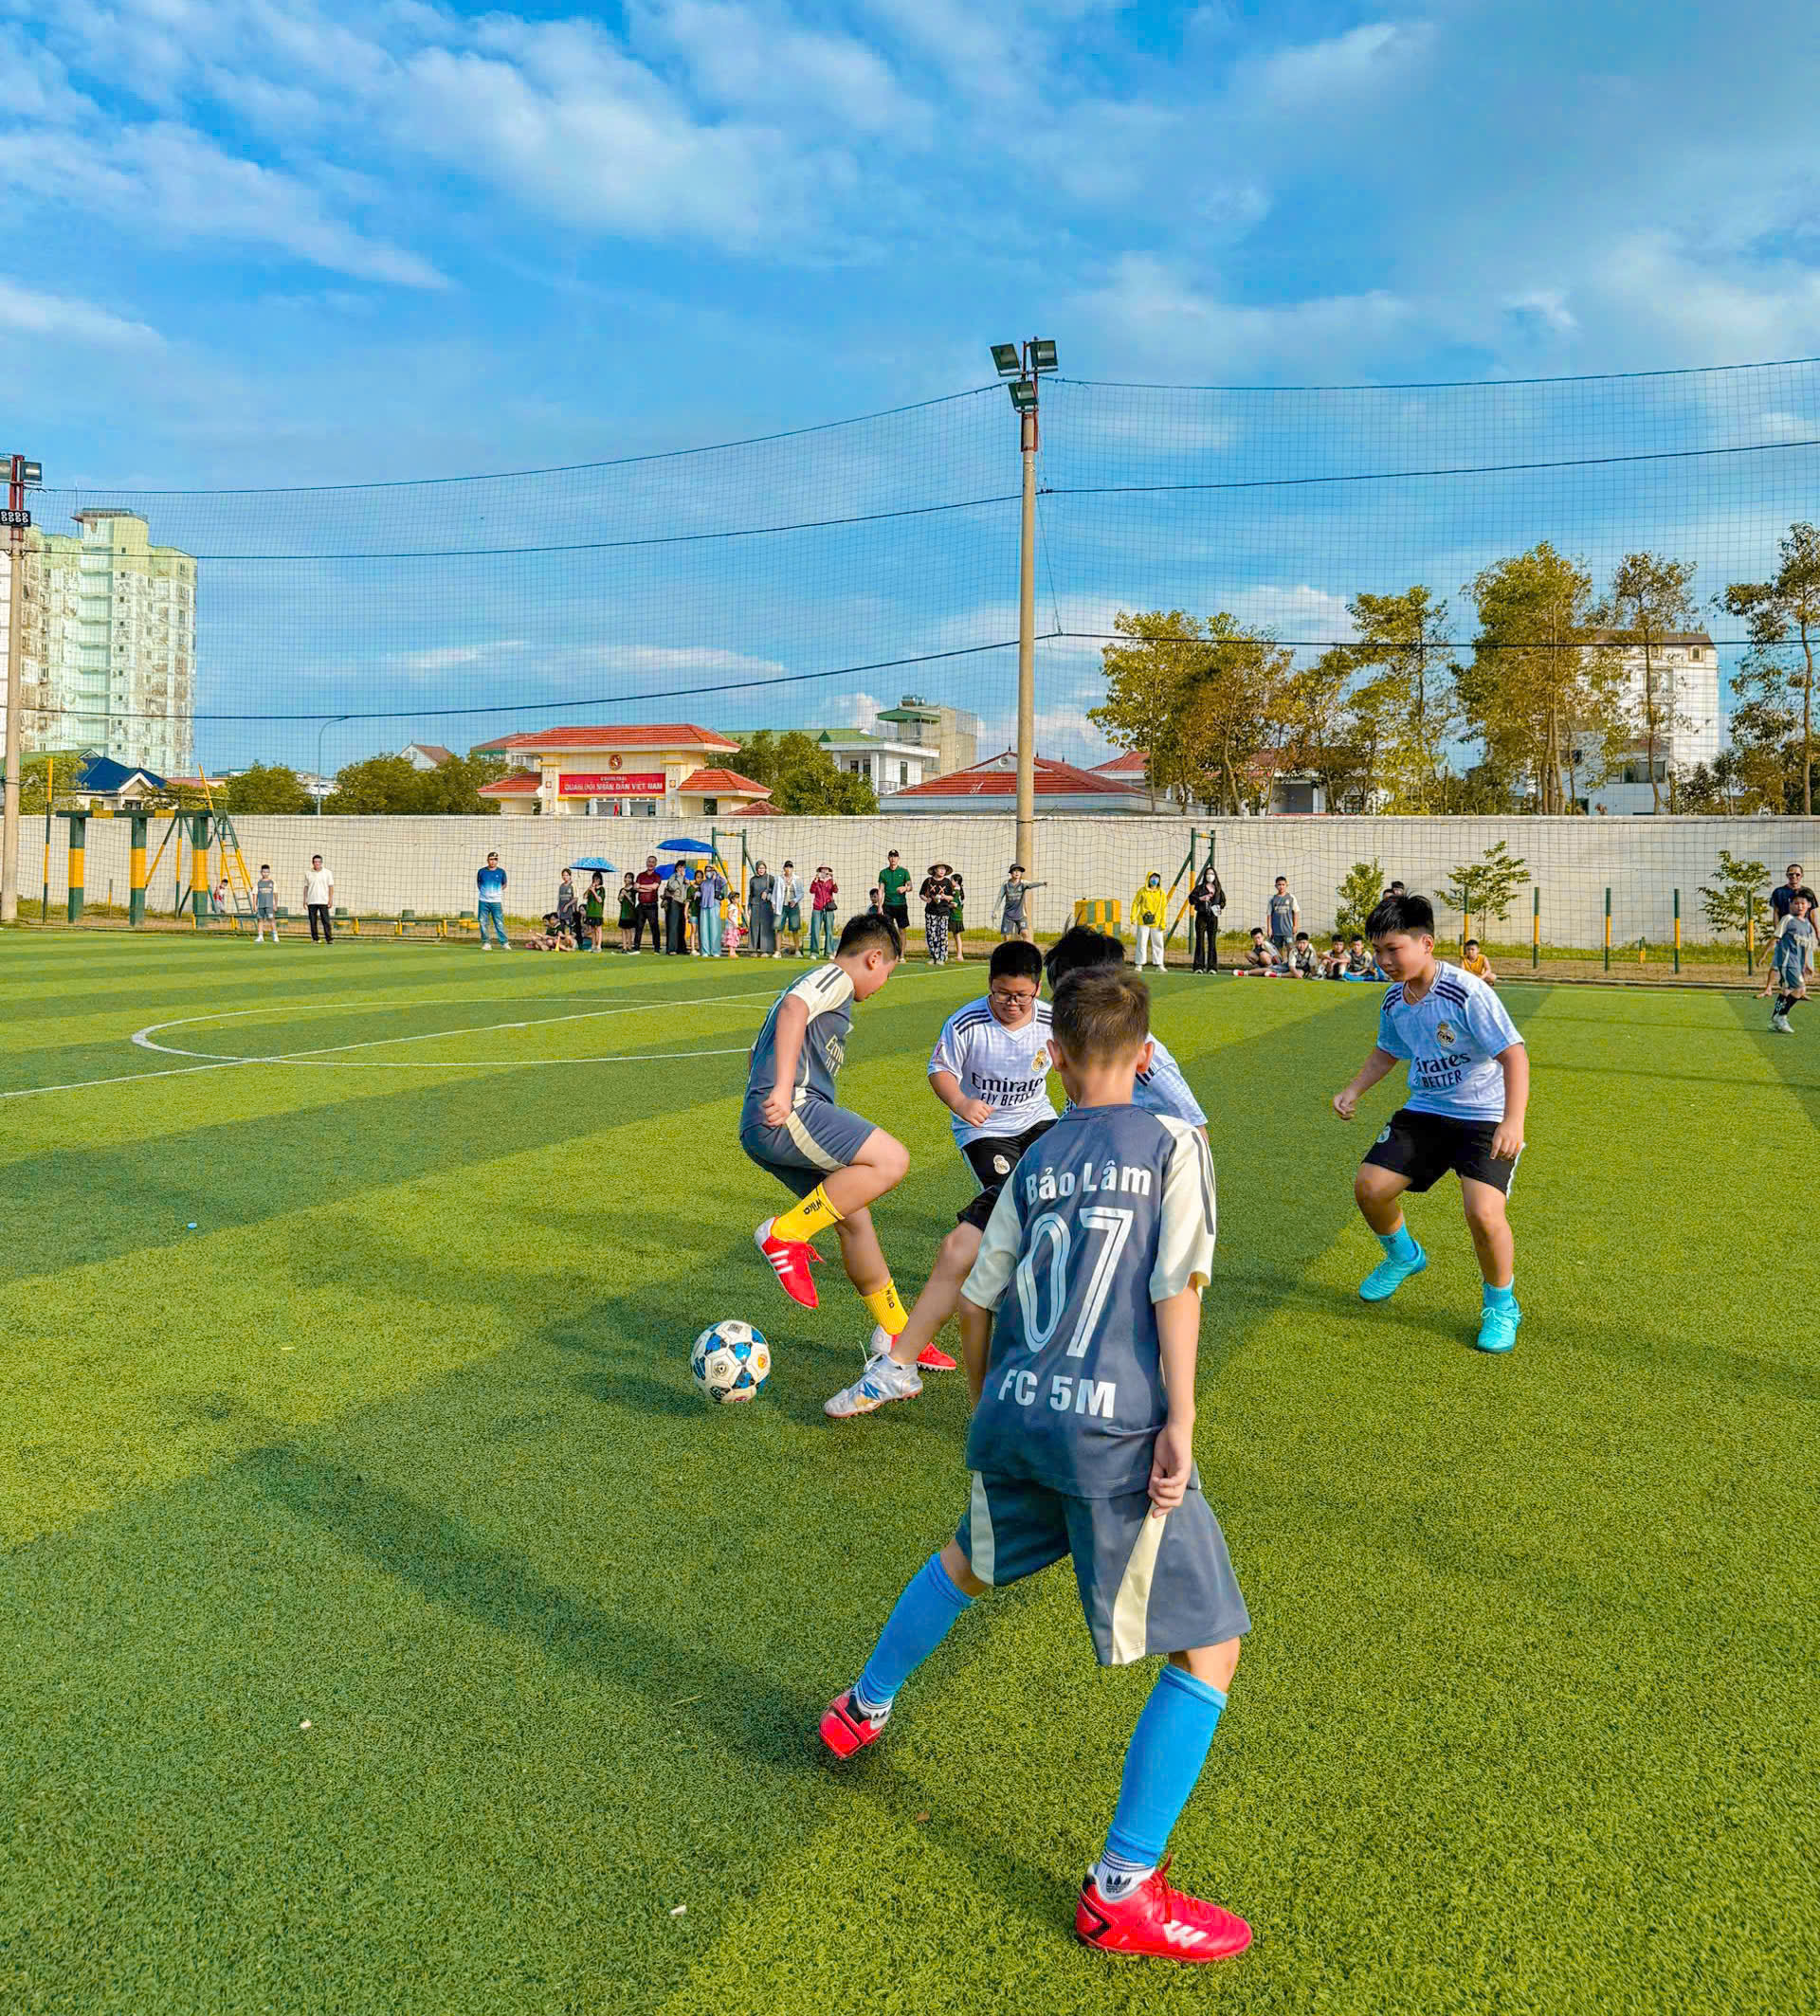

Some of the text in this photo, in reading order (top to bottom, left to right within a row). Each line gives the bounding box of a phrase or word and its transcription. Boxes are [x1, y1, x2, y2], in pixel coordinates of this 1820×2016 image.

[647, 781, 663, 790] NAM
[1421, 1069, 1463, 1088] BETTER
[1026, 1159, 1152, 1207] Bảo Lâm
[1016, 1206, 1134, 1358] 07
[998, 1368, 1117, 1419] FC 5M
